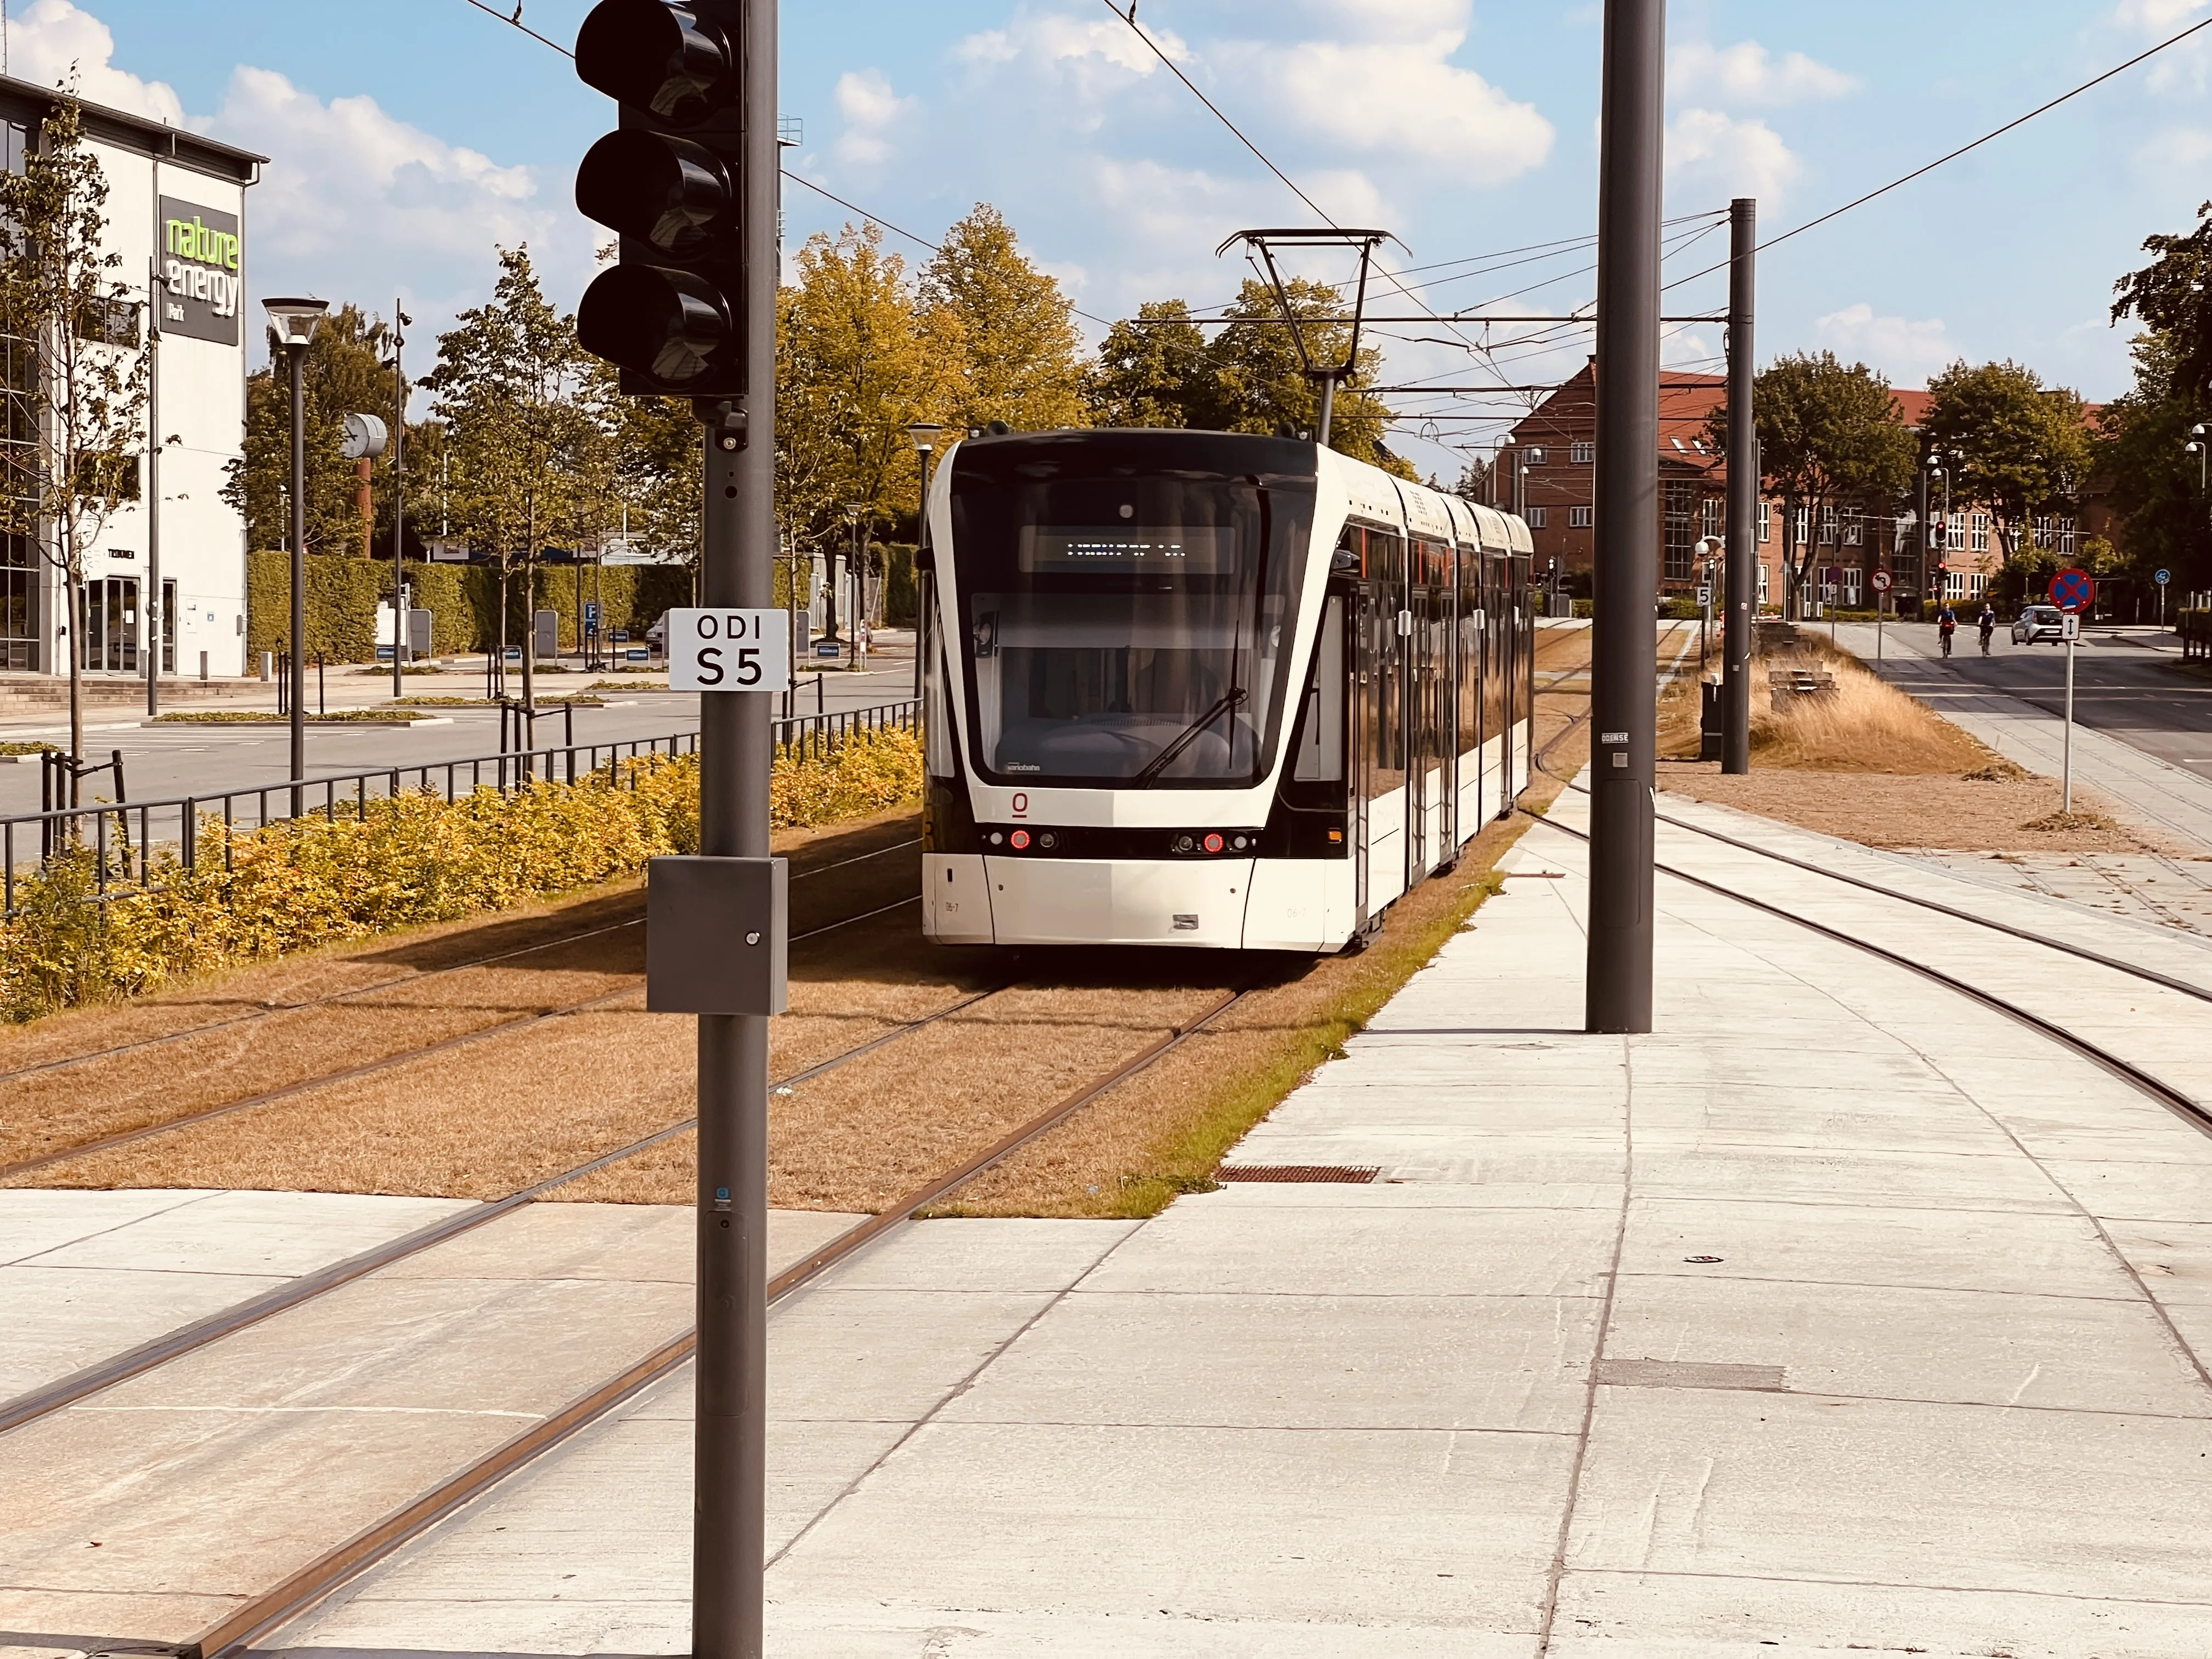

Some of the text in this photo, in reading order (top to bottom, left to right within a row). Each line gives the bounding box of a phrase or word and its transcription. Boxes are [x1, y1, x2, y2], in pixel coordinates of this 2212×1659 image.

[166, 216, 238, 269] nature
[166, 259, 238, 317] energy
[1700, 589, 1709, 602] 5
[697, 615, 760, 639] ODI
[697, 647, 761, 685] S5
